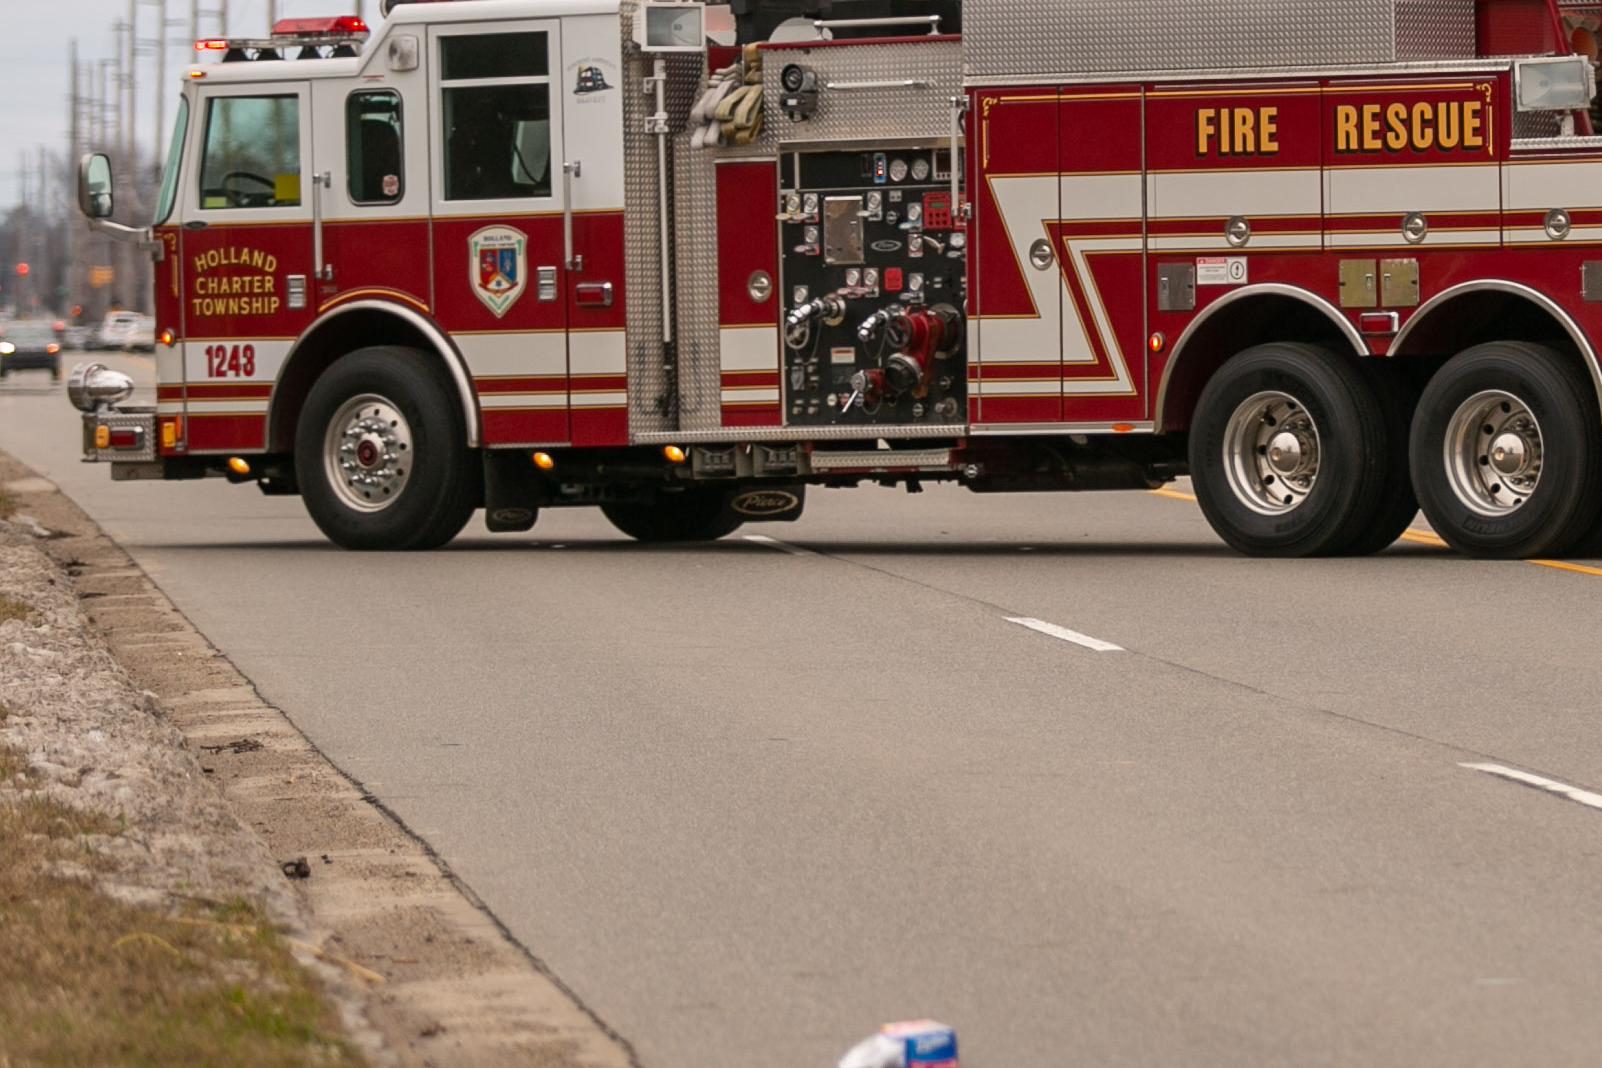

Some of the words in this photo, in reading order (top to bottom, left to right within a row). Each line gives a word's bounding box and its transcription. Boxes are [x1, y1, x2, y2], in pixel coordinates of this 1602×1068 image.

[1196, 106, 1280, 155] FIRE
[1334, 100, 1483, 153] RESCUE
[193, 246, 278, 273] HOLLAND
[196, 275, 275, 295] CHARTER
[192, 296, 281, 316] TOWNSHIP
[205, 344, 256, 378] 1243
